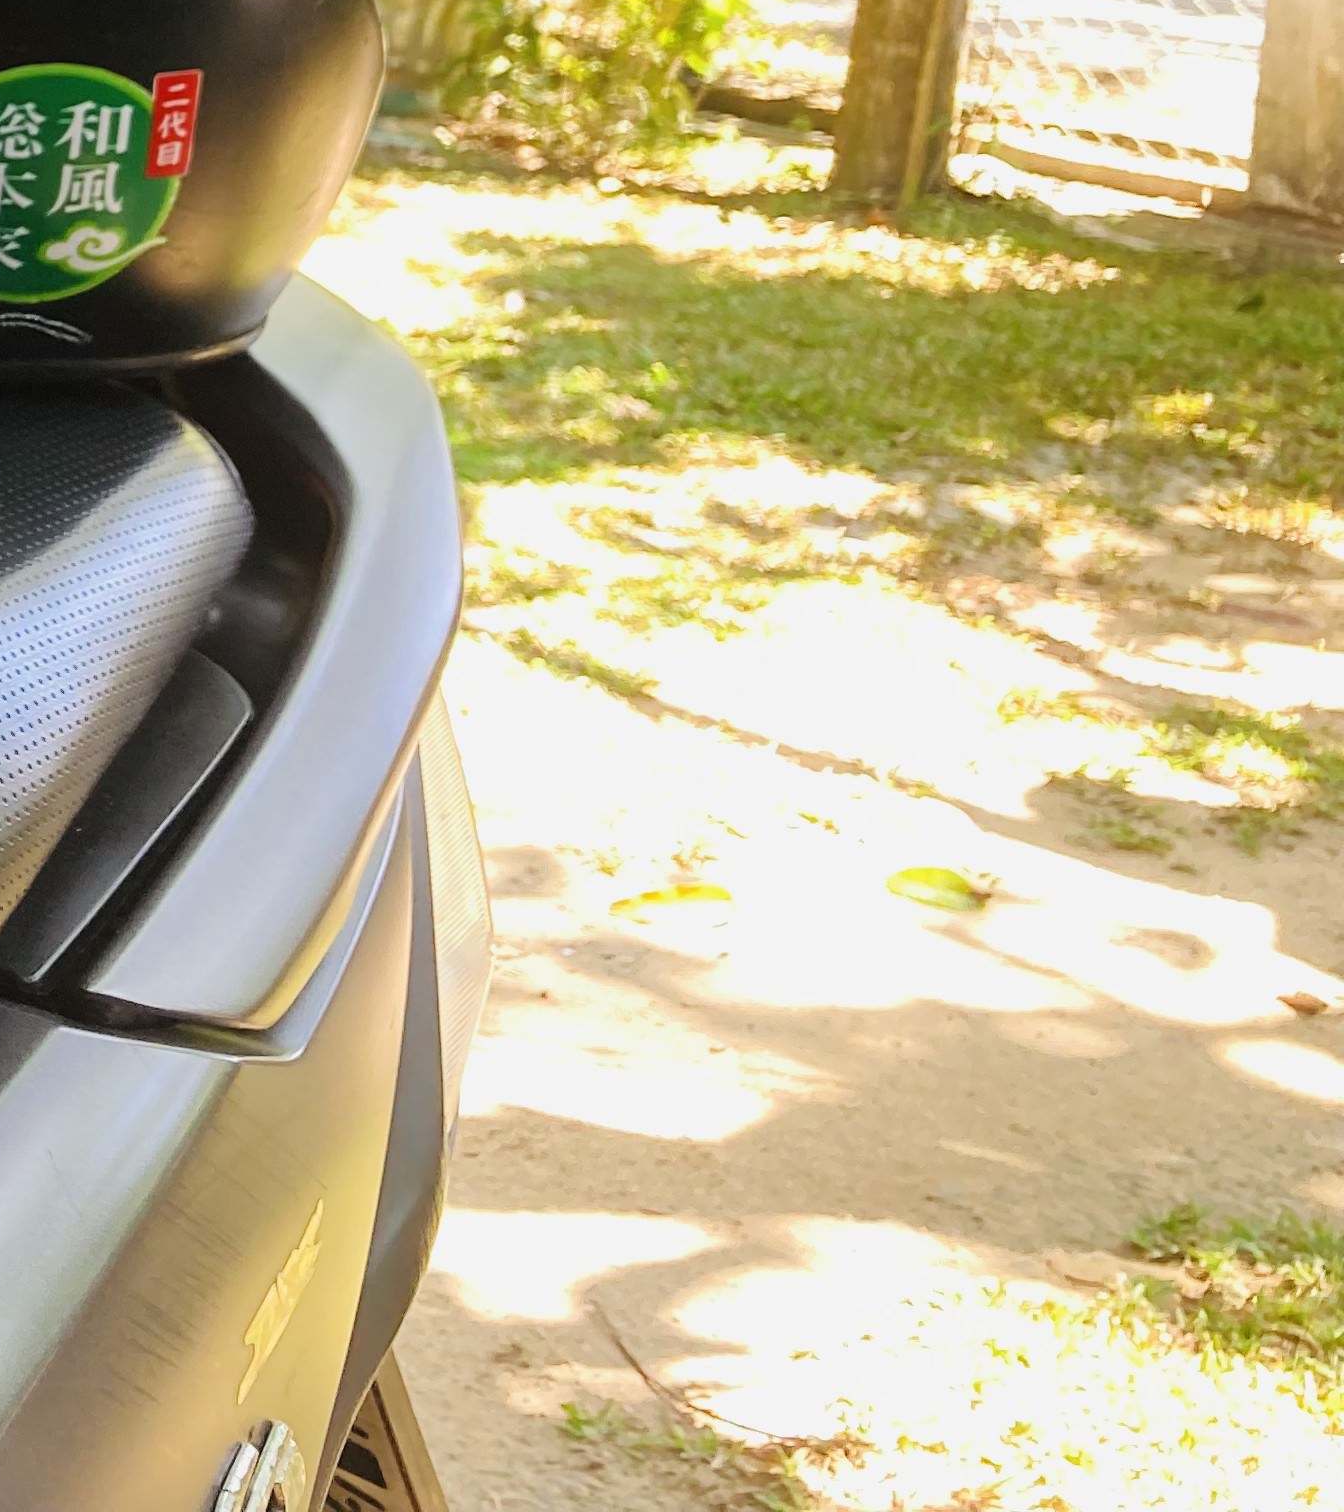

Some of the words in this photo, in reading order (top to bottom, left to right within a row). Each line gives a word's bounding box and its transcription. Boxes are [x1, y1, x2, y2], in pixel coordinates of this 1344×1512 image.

[47, 100, 135, 217] 和風
[155, 82, 190, 168] 二代目
